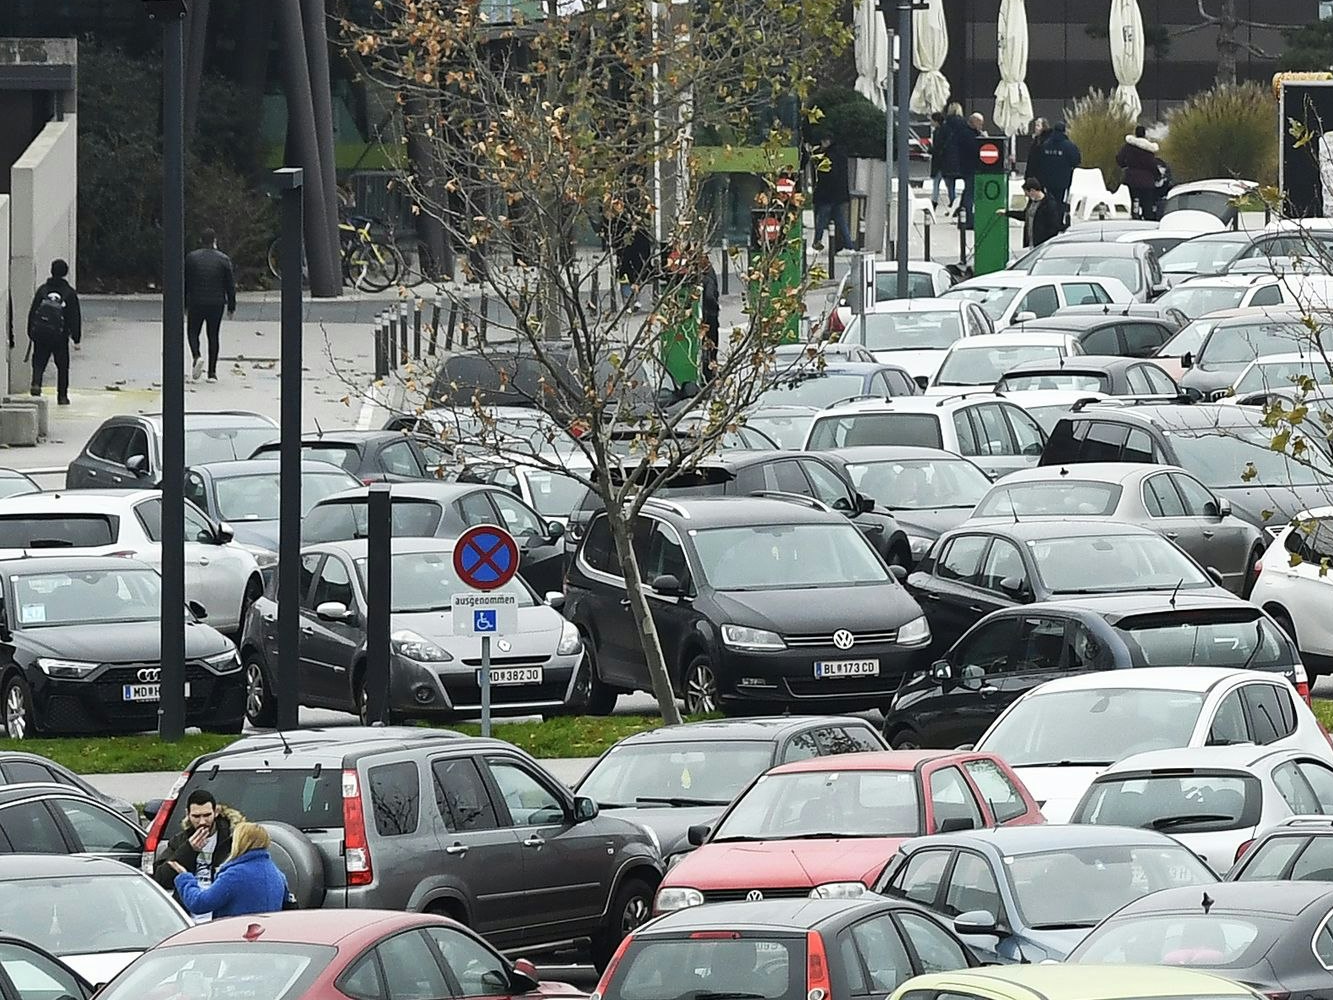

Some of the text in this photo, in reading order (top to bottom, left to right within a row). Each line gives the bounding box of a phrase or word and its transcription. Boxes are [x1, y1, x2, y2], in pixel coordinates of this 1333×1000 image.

[455, 595, 515, 607] ausgenommen
[844, 663, 860, 673] 173
[506, 670, 525, 680] 382
